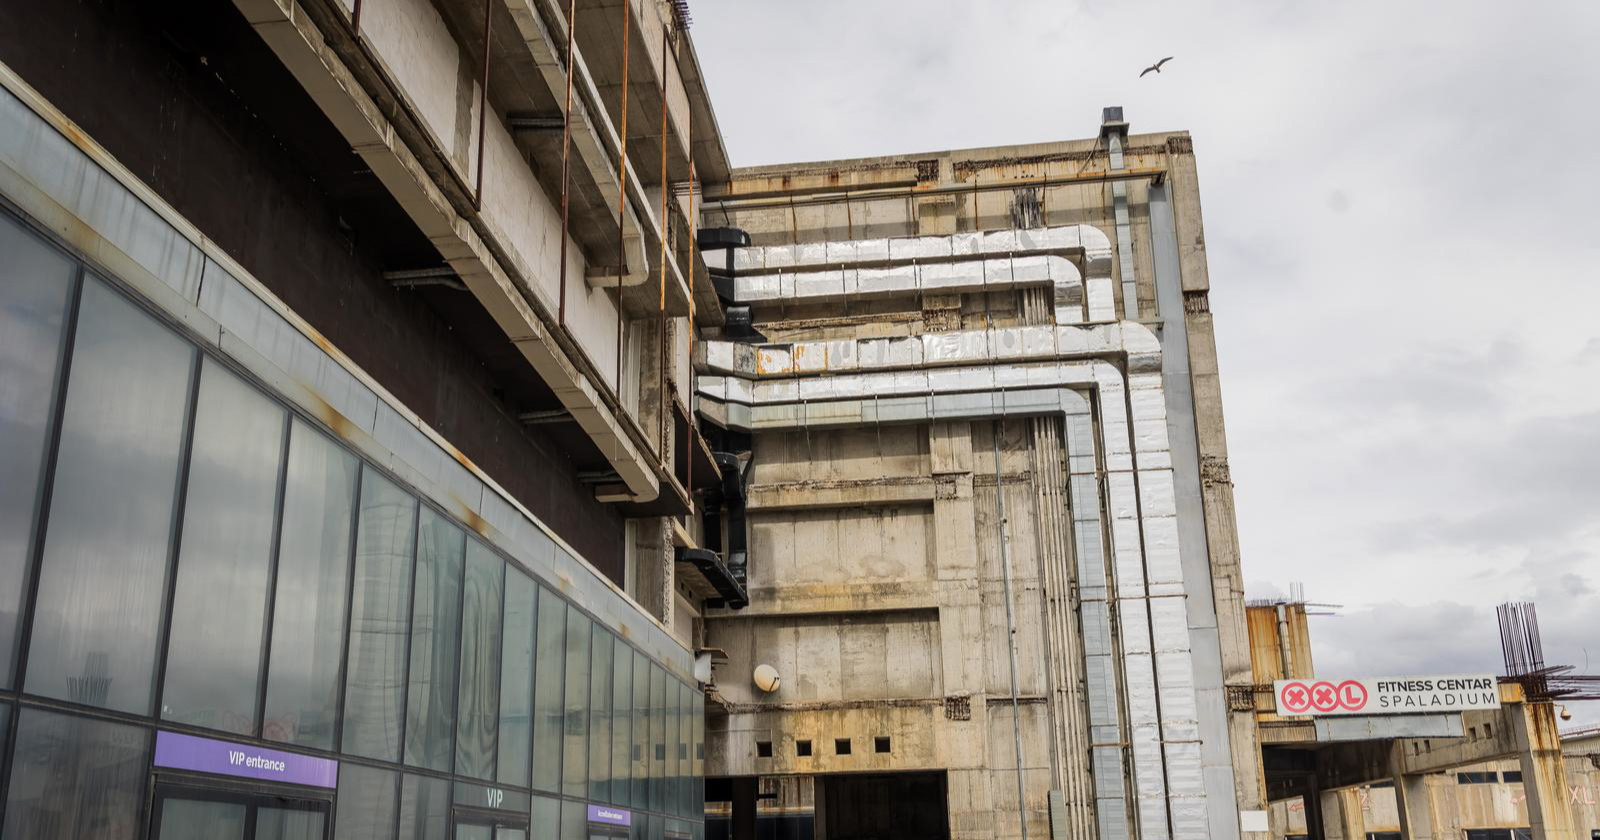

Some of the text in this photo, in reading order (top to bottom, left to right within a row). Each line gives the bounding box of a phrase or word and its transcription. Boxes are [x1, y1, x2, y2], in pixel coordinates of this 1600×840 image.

[1284, 683, 1364, 708] XXL
[1377, 678, 1492, 693] FITNESS CENTAR
[1379, 692, 1496, 708] SPALADIUM
[229, 750, 285, 772] VIP entrance
[487, 788, 503, 808] VIP
